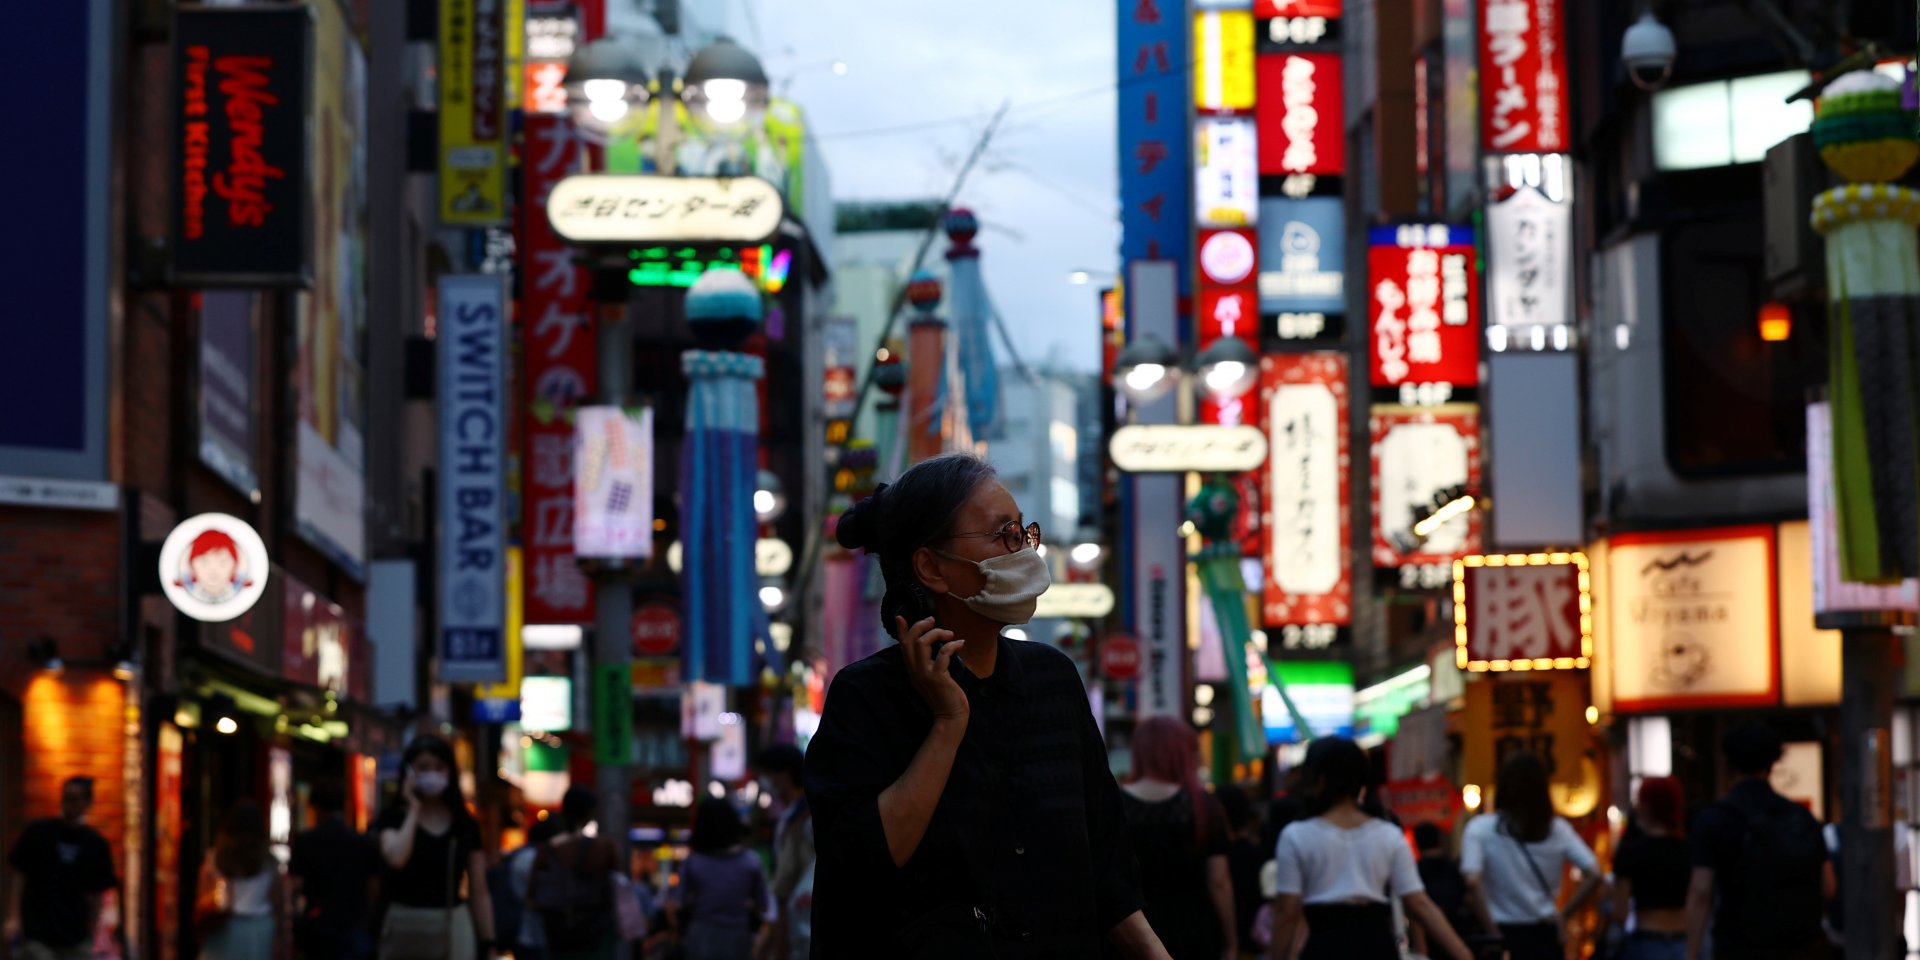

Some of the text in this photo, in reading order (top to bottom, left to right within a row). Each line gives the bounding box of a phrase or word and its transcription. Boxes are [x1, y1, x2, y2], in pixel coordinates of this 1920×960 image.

[183, 44, 210, 241] First Kitchen
[213, 54, 287, 229] Wendy's
[457, 302, 495, 572] SWITCH BAR
[1471, 566, 1574, 661] 豚
